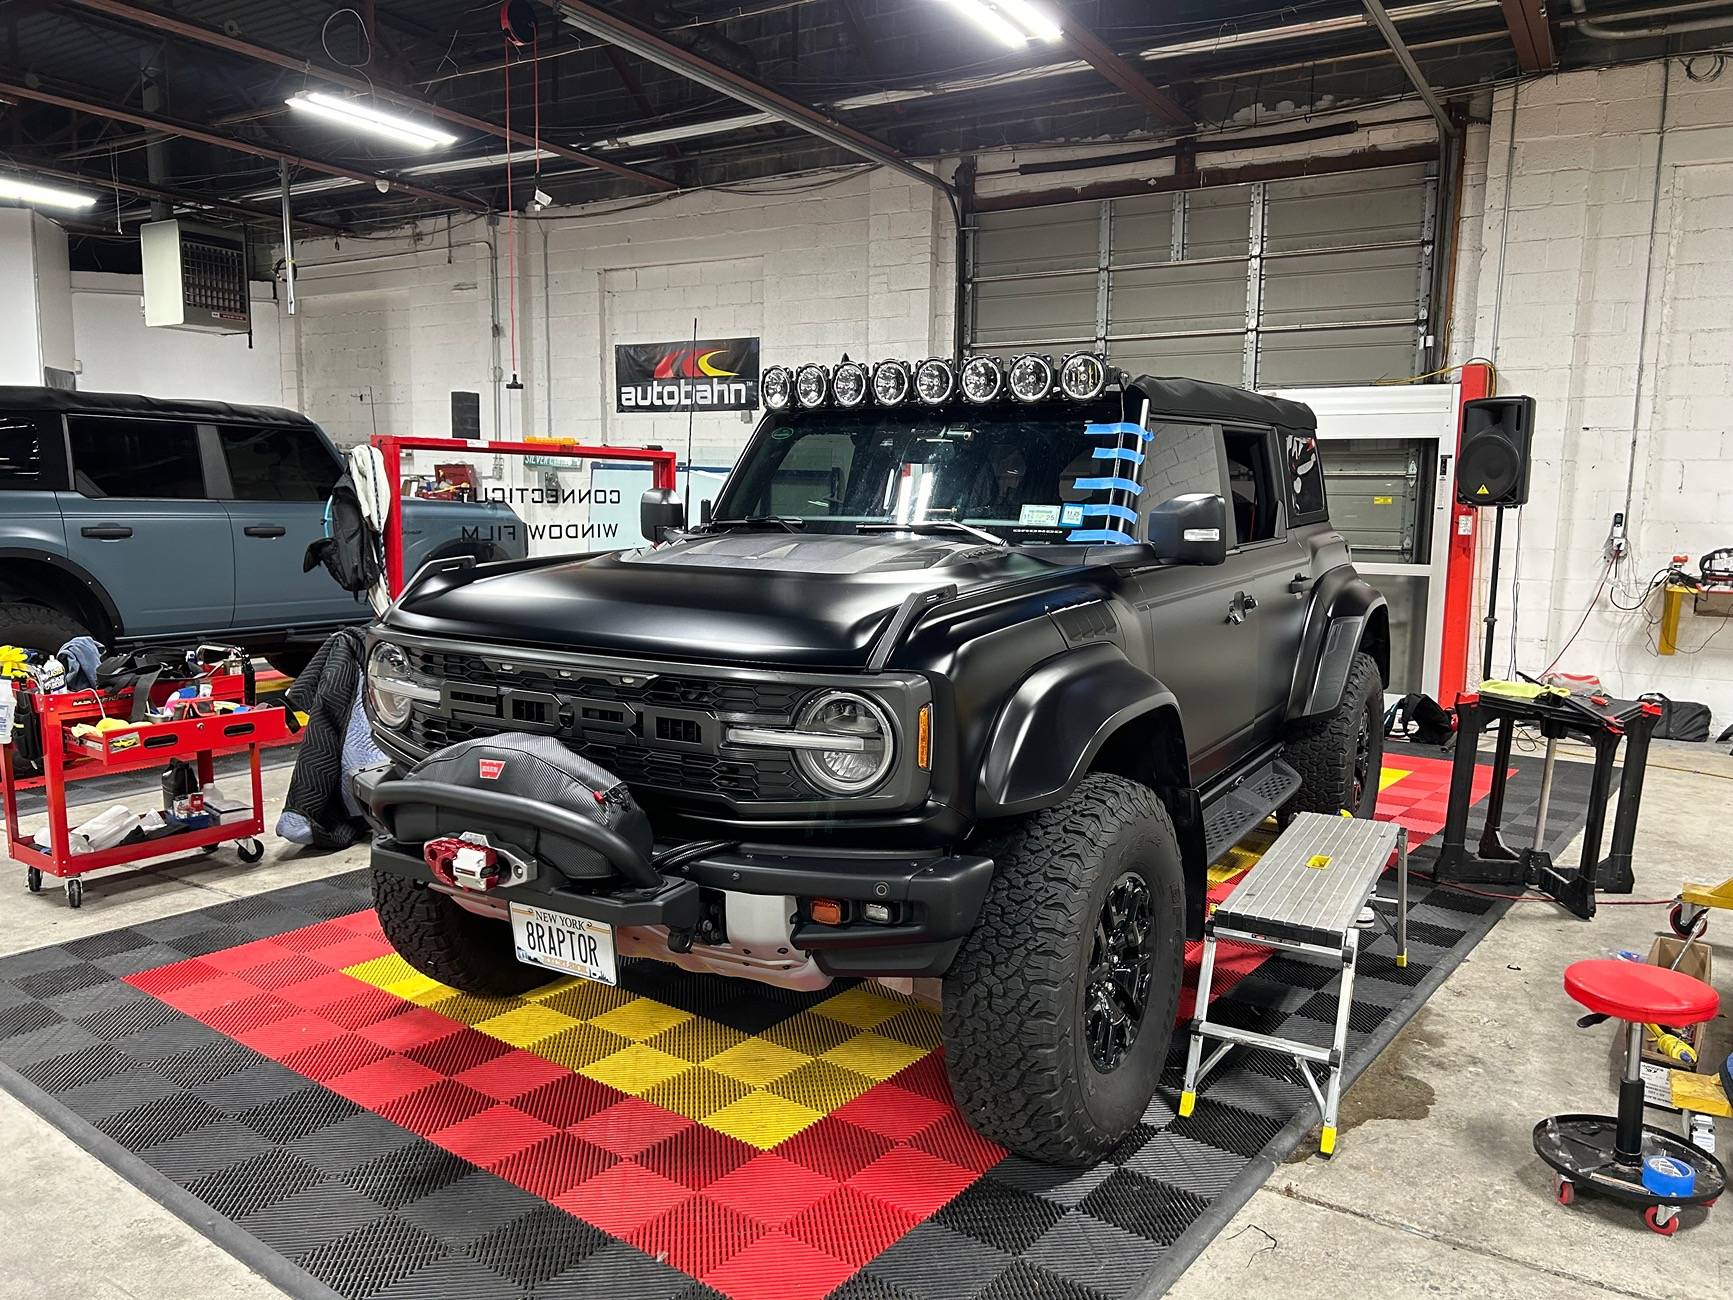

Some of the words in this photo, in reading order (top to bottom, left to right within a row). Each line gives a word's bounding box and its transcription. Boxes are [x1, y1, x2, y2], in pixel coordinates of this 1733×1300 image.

[620, 378, 747, 406] autobahn
[535, 910, 558, 924] NEW
[560, 915, 586, 931] YORK
[526, 921, 599, 967] 8RAPTOR
